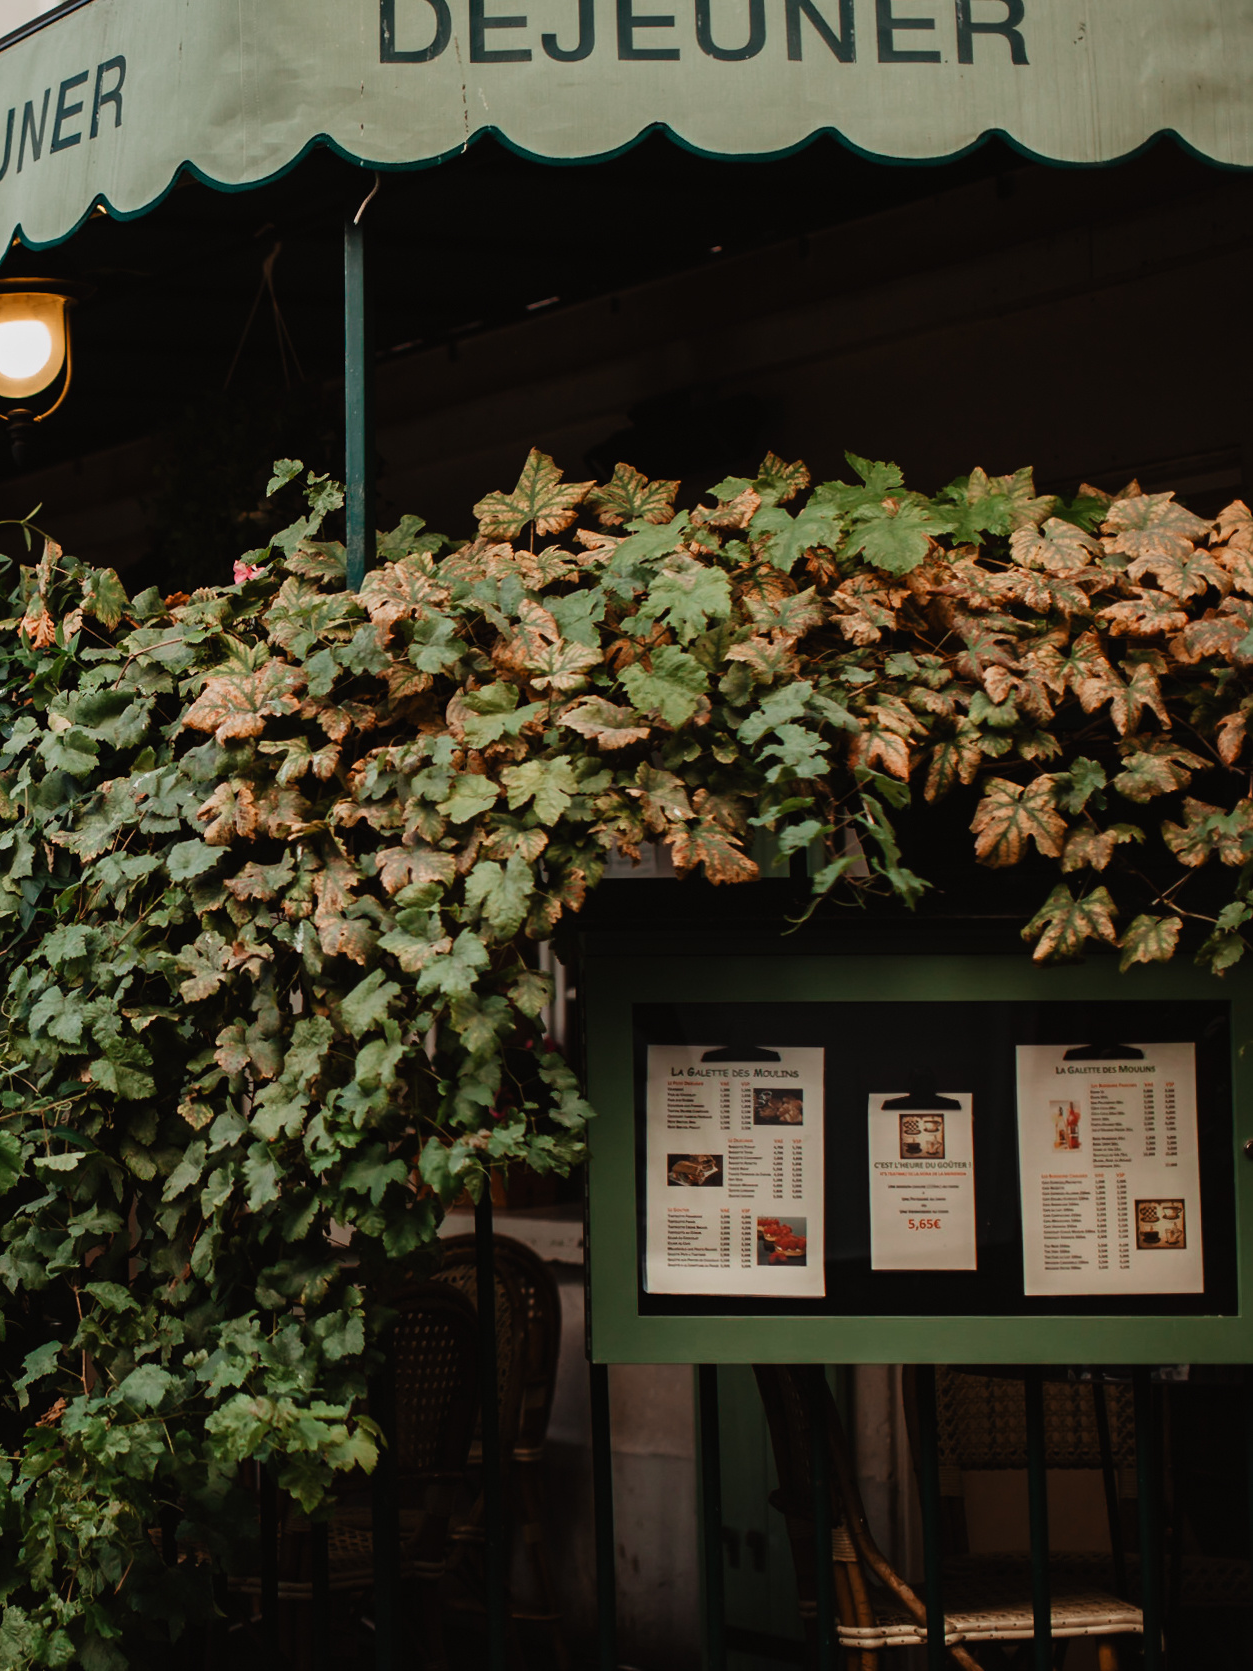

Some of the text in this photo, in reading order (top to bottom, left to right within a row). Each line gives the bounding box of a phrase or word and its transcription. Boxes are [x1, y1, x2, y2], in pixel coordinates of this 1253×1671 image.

[379, 0, 1030, 65] DEJEUNER
[671, 1067, 800, 1078] LA GALETTE DES MOULINS
[1055, 1065, 1156, 1075] LA GALETTE DES MOULINS
[908, 1219, 941, 1231] 5,65€
